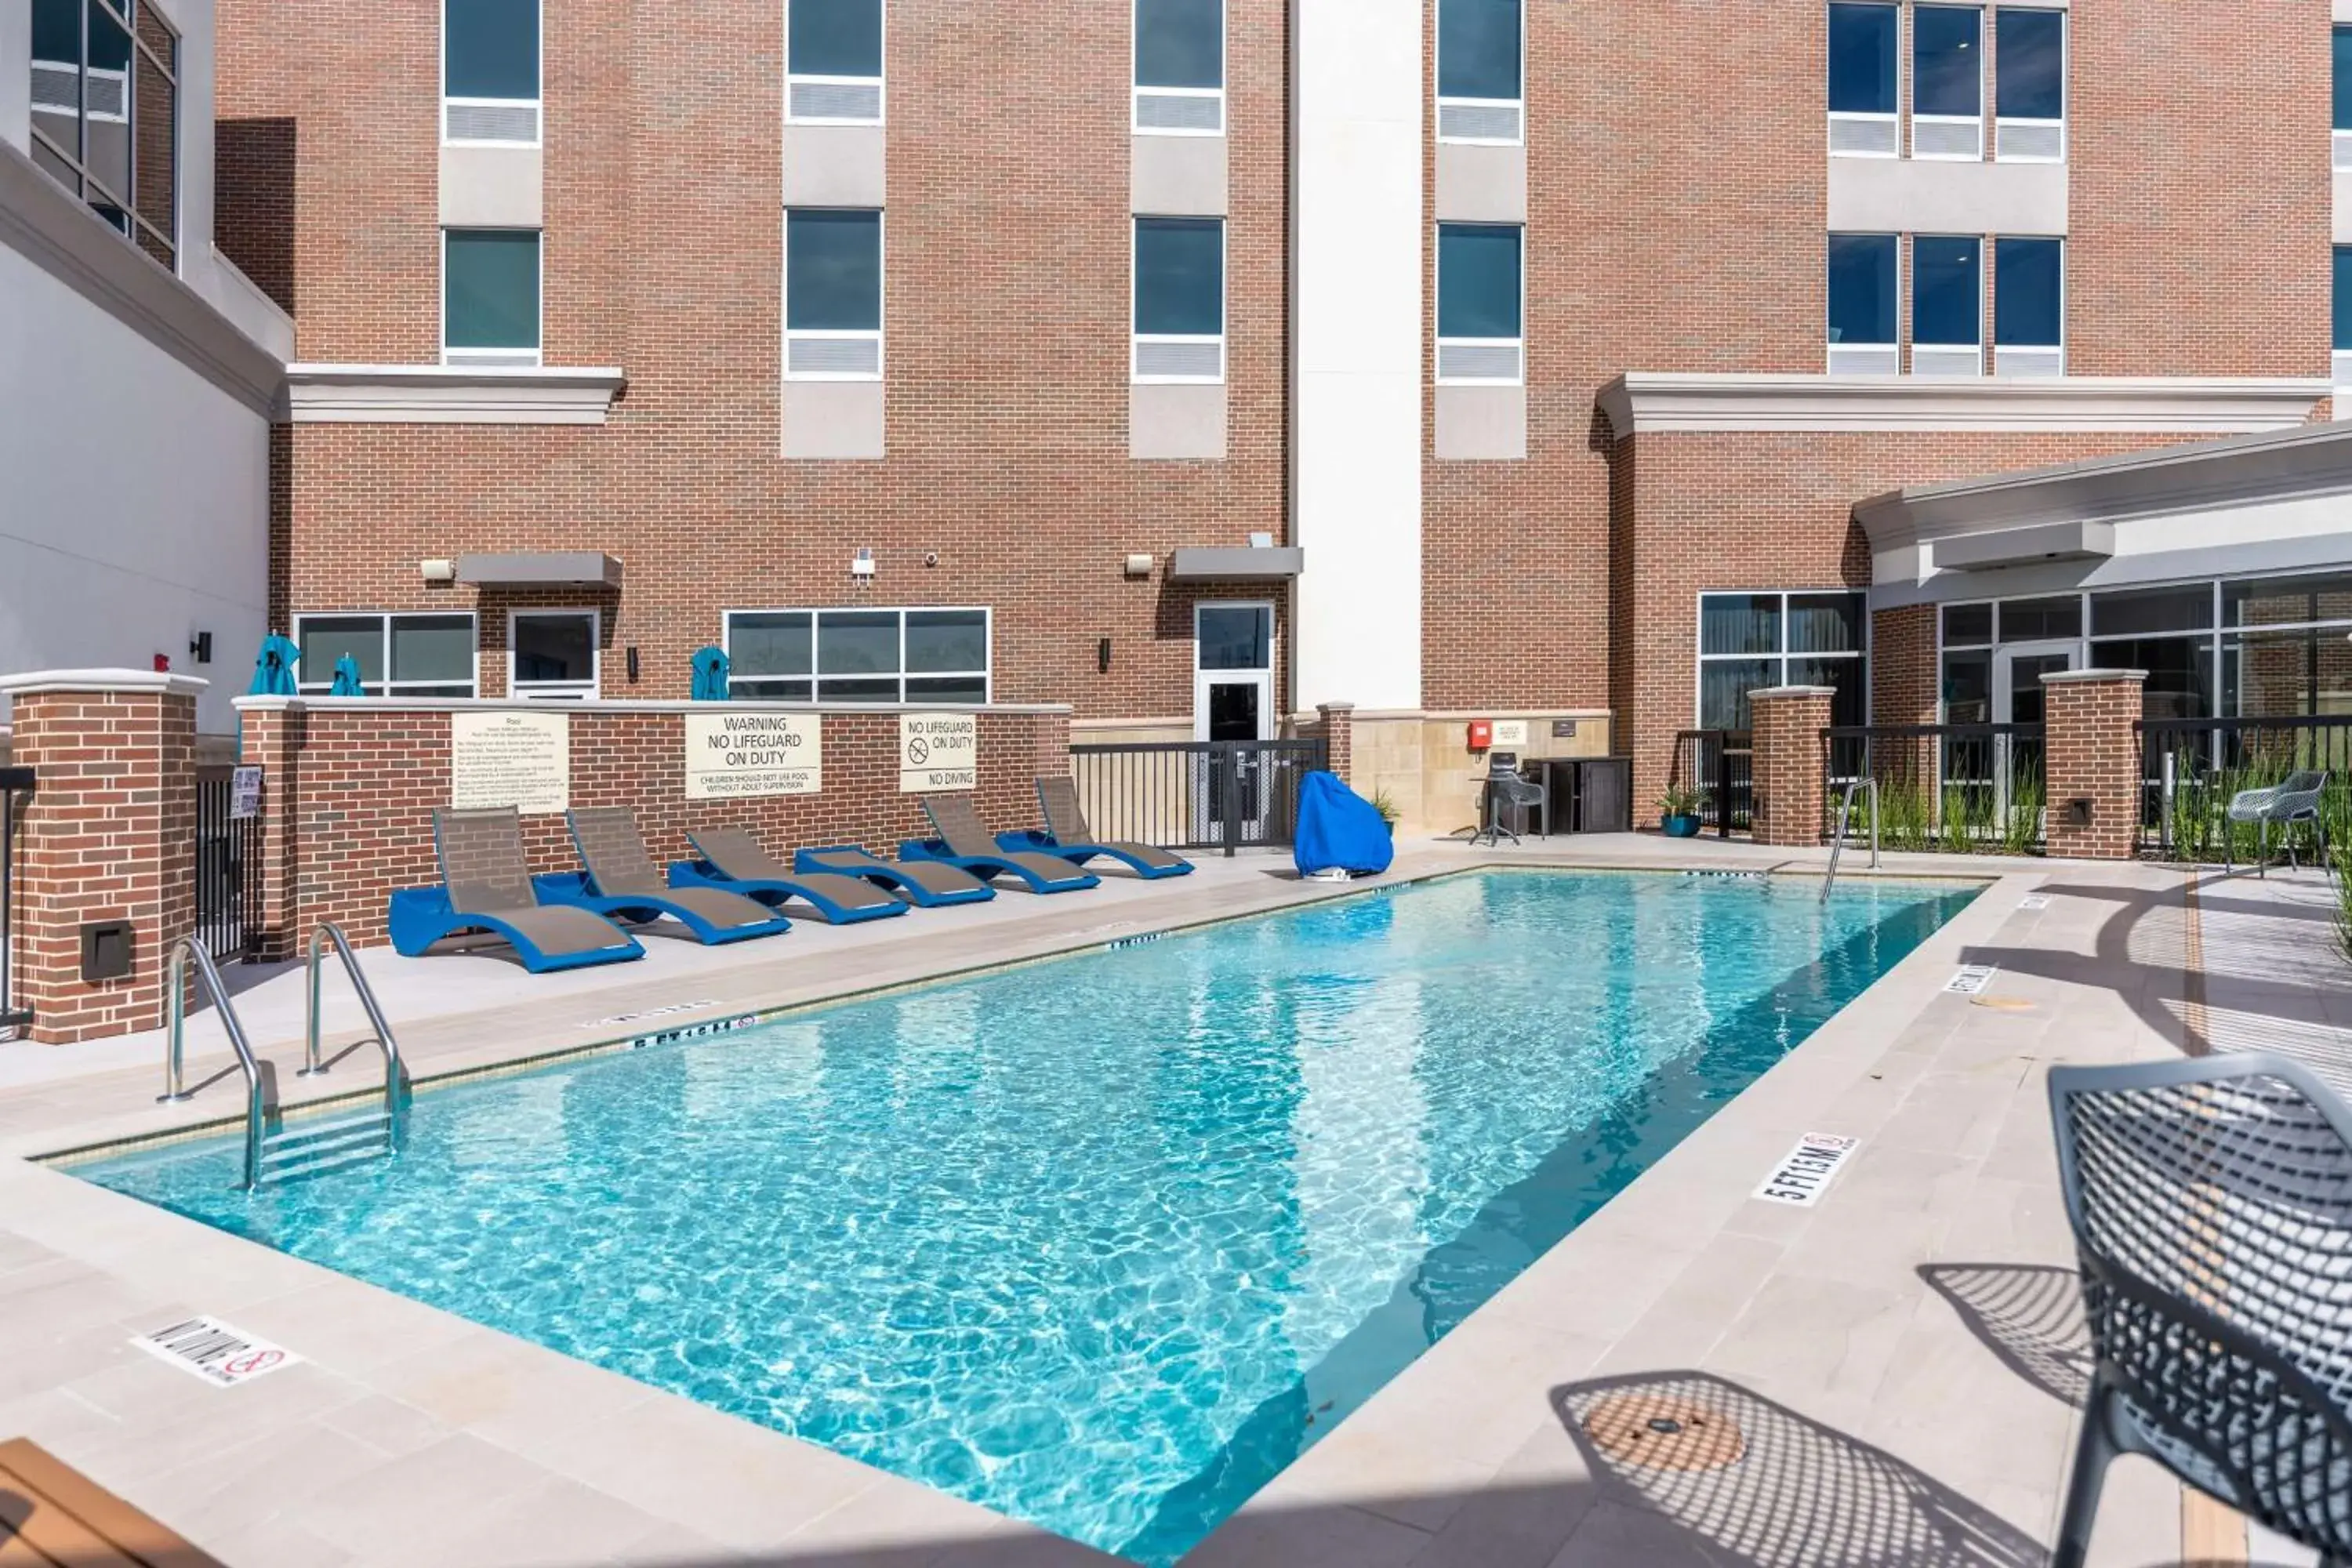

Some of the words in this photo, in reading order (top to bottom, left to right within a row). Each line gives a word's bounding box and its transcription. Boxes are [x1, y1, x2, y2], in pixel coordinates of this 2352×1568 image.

[724, 717, 786, 731] WARNING
[909, 721, 924, 733] NO
[926, 721, 973, 733] LIFEGUARD
[708, 735, 730, 749] NO
[734, 734, 802, 748] LIFEGUARD
[932, 736, 947, 749] ON
[949, 736, 973, 749] DUTY
[726, 752, 746, 766] ON
[750, 750, 786, 764] DUTY
[700, 775, 733, 785] CHILDREN
[733, 774, 761, 783] SHOULD
[763, 773, 777, 782] NOT
[792, 772, 809, 781] POOL
[929, 772, 943, 786] NO
[945, 772, 973, 784] DIVING
[706, 783, 739, 793] WITHOUT
[1797, 1145, 1842, 1161] M
[1773, 1171, 1820, 1189] FT
[1763, 1188, 1807, 1200] 5
